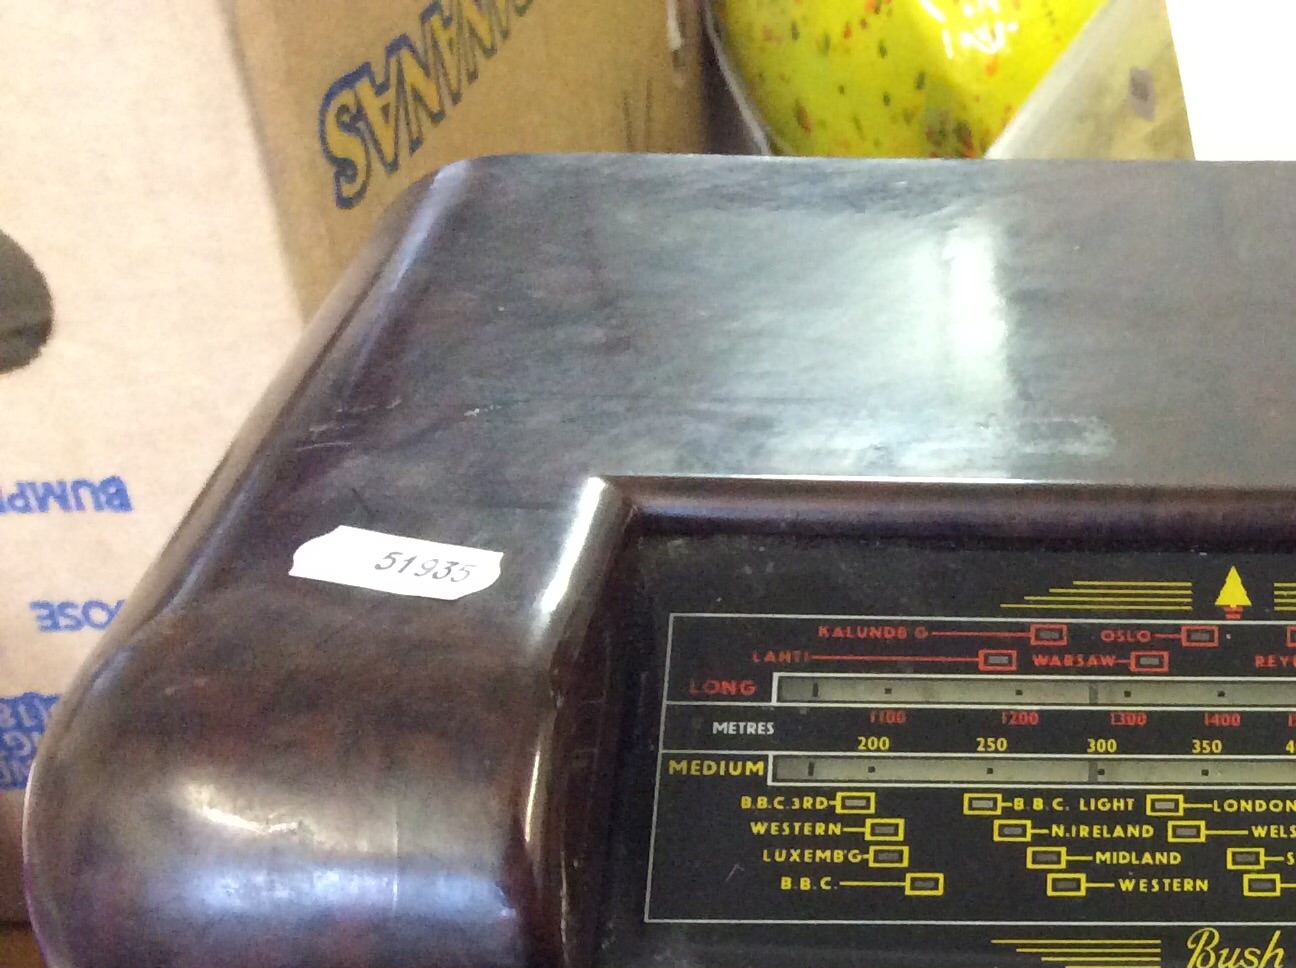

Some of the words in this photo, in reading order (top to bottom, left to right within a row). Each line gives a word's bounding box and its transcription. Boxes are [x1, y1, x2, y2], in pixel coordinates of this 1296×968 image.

[0, 475, 133, 515] BUMP
[374, 551, 478, 583] 51935
[1100, 629, 1151, 643] OSLO
[752, 650, 809, 664] LAHTI
[1032, 654, 1116, 667] WARSAW
[689, 679, 757, 696] LONG
[870, 710, 907, 724] 1100
[1002, 711, 1040, 725] 1200
[1110, 712, 1147, 726] 1300
[1204, 713, 1241, 727] 1400
[712, 722, 775, 735] METRES
[857, 736, 889, 750] 200
[976, 738, 1008, 751] 250
[1087, 739, 1117, 753] 300
[1192, 739, 1222, 753] 350
[668, 760, 764, 776] MEDIUM
[1079, 798, 1135, 811] LIGHT
[750, 822, 842, 835] WESTERN
[1095, 851, 1181, 865] MIDLAND
[1118, 878, 1209, 892] WESTERN
